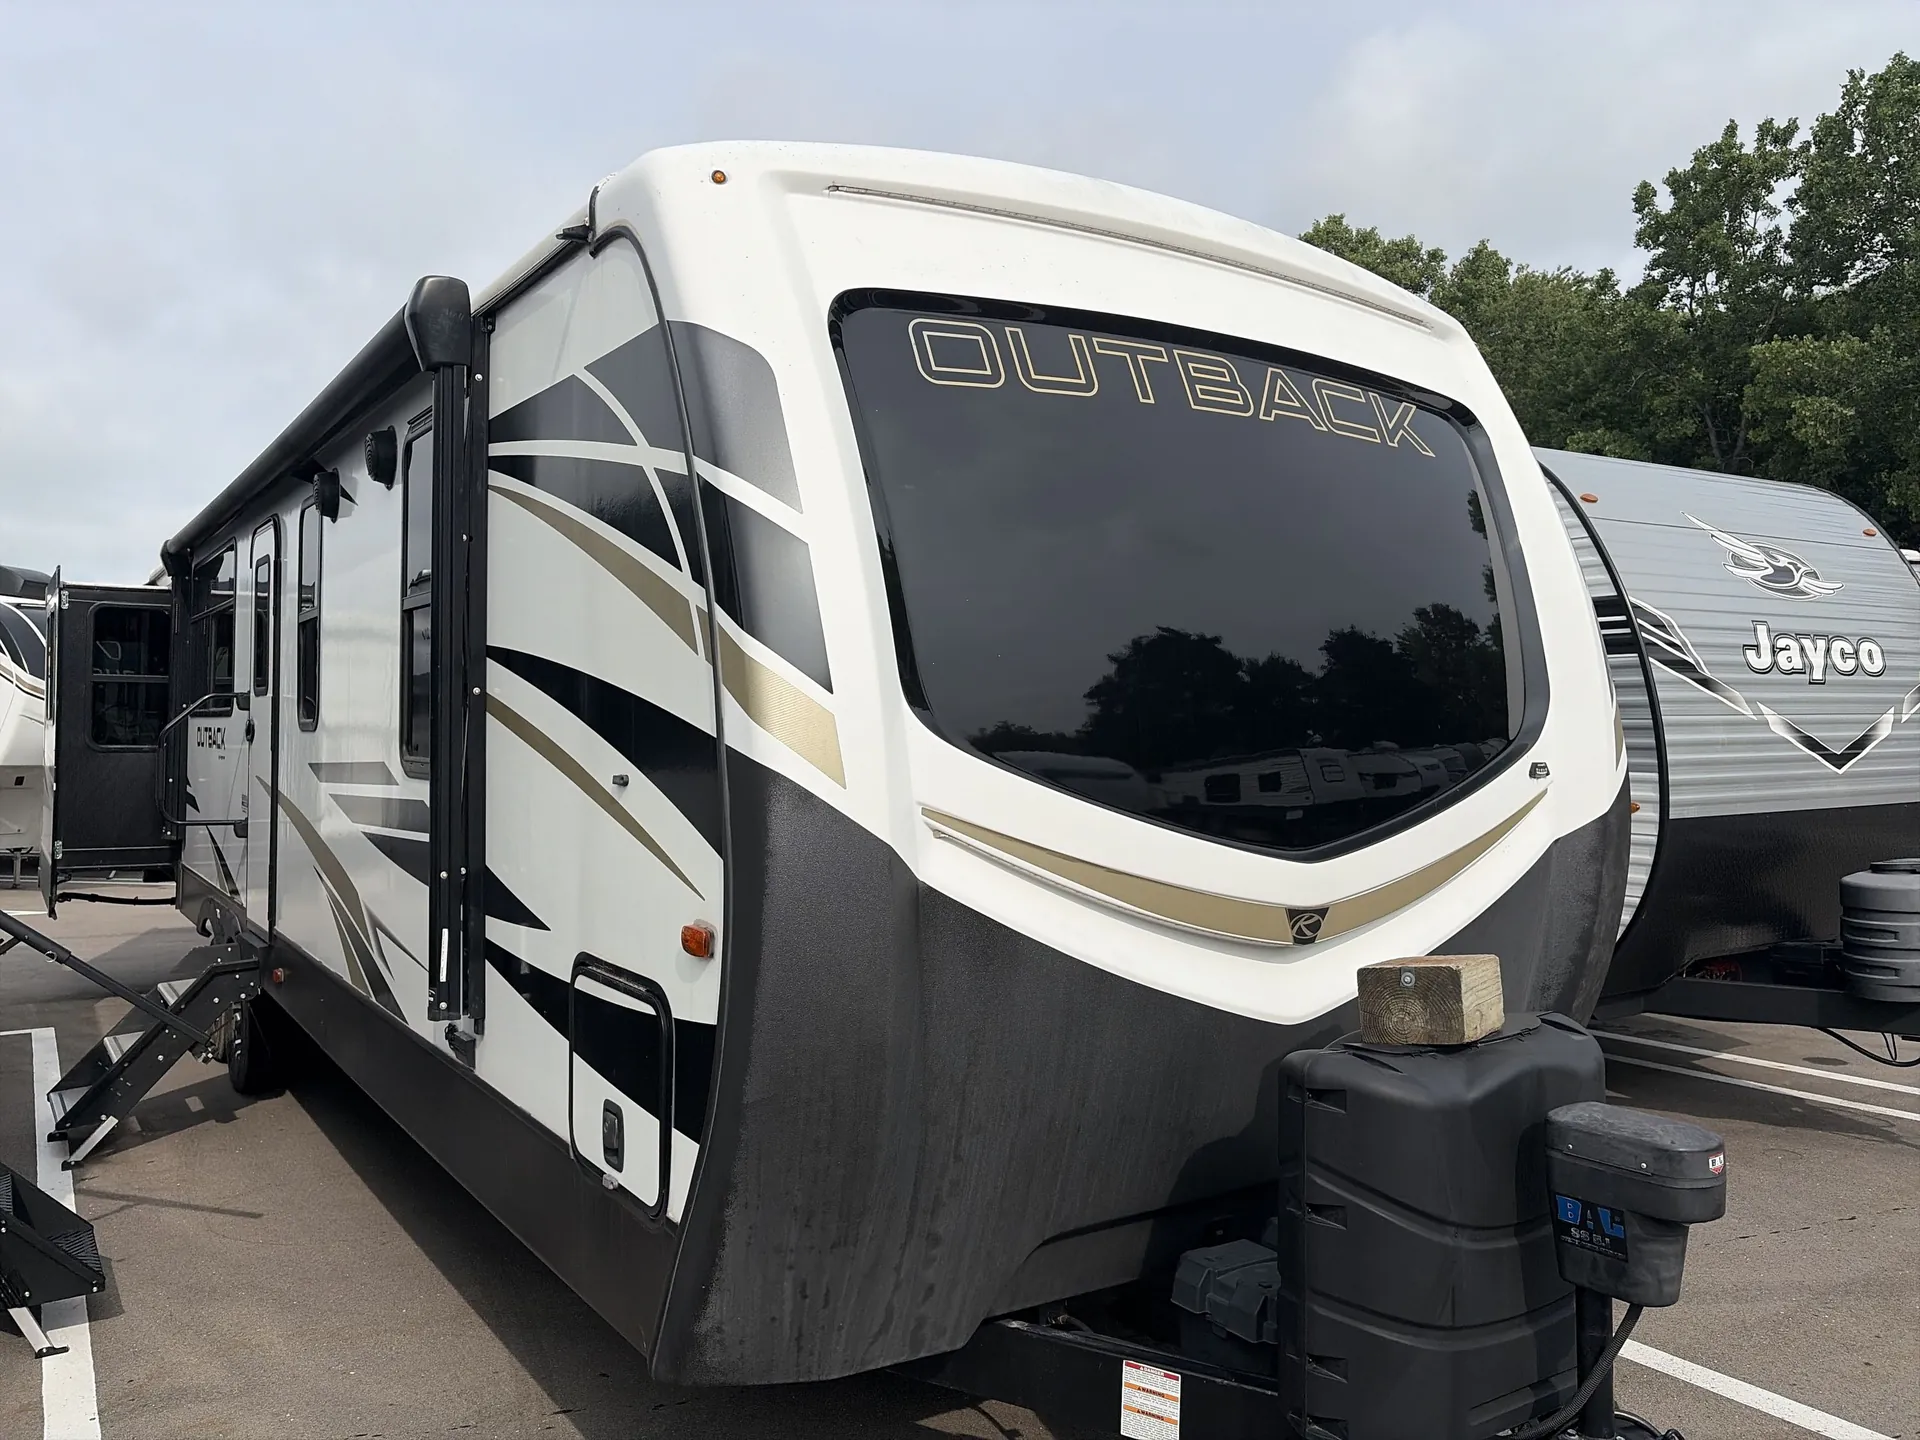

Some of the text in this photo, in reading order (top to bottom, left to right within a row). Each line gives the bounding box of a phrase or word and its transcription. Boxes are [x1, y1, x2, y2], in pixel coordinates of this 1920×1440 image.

[908, 317, 1436, 458] OUTBACK
[1743, 620, 1887, 685] Jayco
[197, 726, 226, 751] OUTBACK
[1556, 1195, 1625, 1239] BAL
[1143, 1367, 1165, 1377] DANGER
[1141, 1387, 1165, 1398] WARNING
[1140, 1409, 1165, 1421] WARNING
